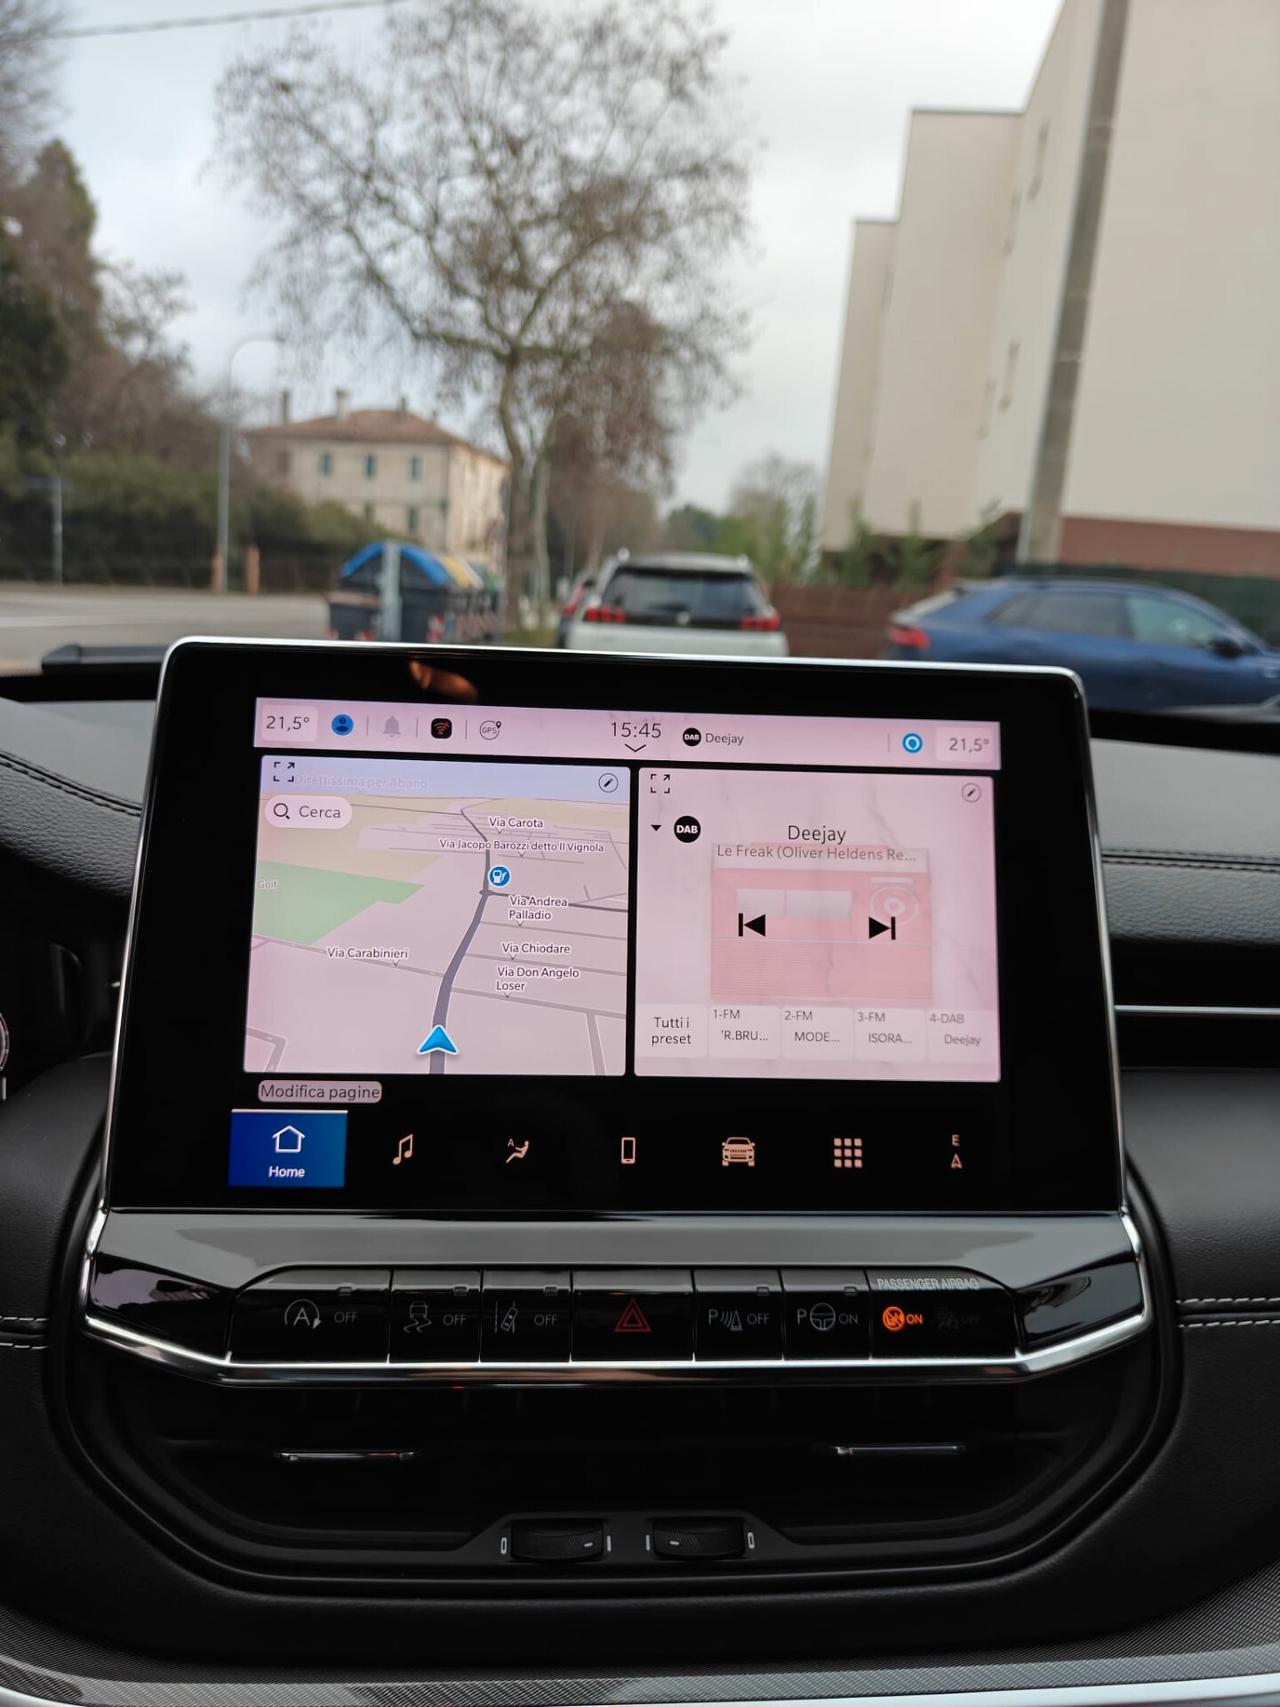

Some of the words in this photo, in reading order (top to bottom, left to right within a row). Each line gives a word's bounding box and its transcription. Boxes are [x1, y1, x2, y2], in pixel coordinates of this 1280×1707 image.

[266, 715, 310, 730] 21,5°
[482, 726, 497, 734] GPS
[611, 722, 662, 739] 15:45
[683, 733, 700, 741] DAB
[705, 733, 744, 745] Deejay
[948, 737, 989, 752] 21,5°
[299, 806, 341, 819] Cerca
[489, 817, 505, 828] Via
[508, 817, 544, 829] Carota
[675, 825, 698, 834] DAB
[788, 825, 846, 845] Deejay
[440, 839, 454, 849] Via
[456, 840, 491, 852] Jacopo
[494, 841, 528, 851] Barozzi
[531, 841, 557, 852] detto
[567, 842, 604, 855] Vignola
[717, 845, 733, 857] Le
[736, 845, 773, 858] Freak
[777, 845, 822, 860] (Oliver
[827, 847, 883, 861] Heldens
[257, 879, 277, 889] Golf
[510, 896, 525, 907] Via
[526, 896, 567, 908] Andrea
[509, 909, 552, 921] Palladio
[327, 948, 344, 959] Via
[347, 948, 408, 960] Carabinieri
[502, 942, 518, 953] Via
[521, 943, 570, 955] Chiodare
[497, 967, 513, 977] Via
[517, 967, 537, 978] Don
[540, 967, 579, 980] Angelo
[496, 981, 525, 992] Loser
[713, 1009, 740, 1020] 1-FM
[785, 1010, 813, 1021] 2-FM
[857, 1011, 885, 1023] 3-FM
[929, 1013, 965, 1024] 4-DAB
[653, 1016, 683, 1029] Tutti
[651, 1032, 692, 1047] preset
[944, 1034, 981, 1047] Deejay
[260, 1084, 325, 1098] Modifica
[329, 1086, 380, 1101] pagine
[268, 1166, 305, 1178] Home
[877, 1278, 938, 1290] PASSENGER
[941, 1278, 979, 1290] AIRBAG
[334, 1311, 358, 1324] OFF
[443, 1314, 467, 1326] OFF
[534, 1314, 558, 1326] OFF
[709, 1309, 718, 1322] P
[747, 1313, 770, 1325] OFF
[797, 1309, 807, 1323] P
[839, 1313, 858, 1325] ON
[906, 1313, 923, 1325] ON
